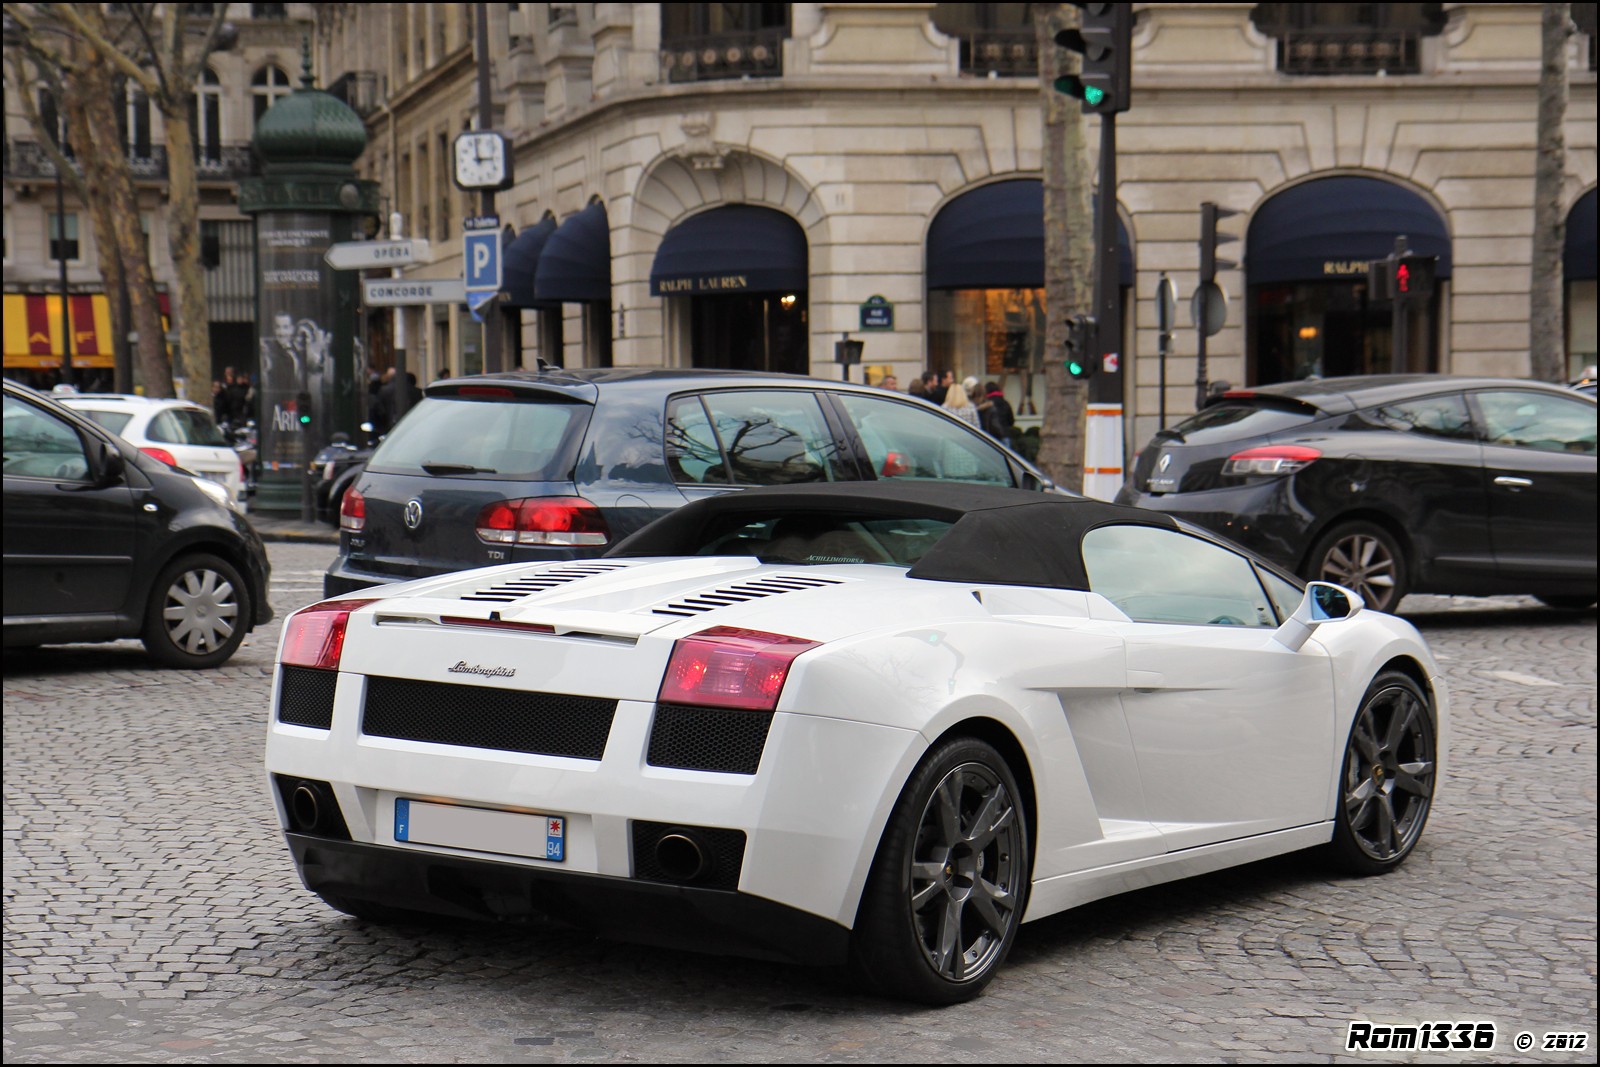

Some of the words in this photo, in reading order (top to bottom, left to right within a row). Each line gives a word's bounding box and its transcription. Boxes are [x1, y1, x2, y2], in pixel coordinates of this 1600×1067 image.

[659, 278, 693, 292] RALPH
[698, 275, 747, 290] LAUREN
[370, 286, 433, 298] CONCORDE
[487, 550, 504, 560] TDI
[447, 660, 517, 679] Lamborghini
[399, 824, 405, 834] F
[547, 841, 561, 857] 94
